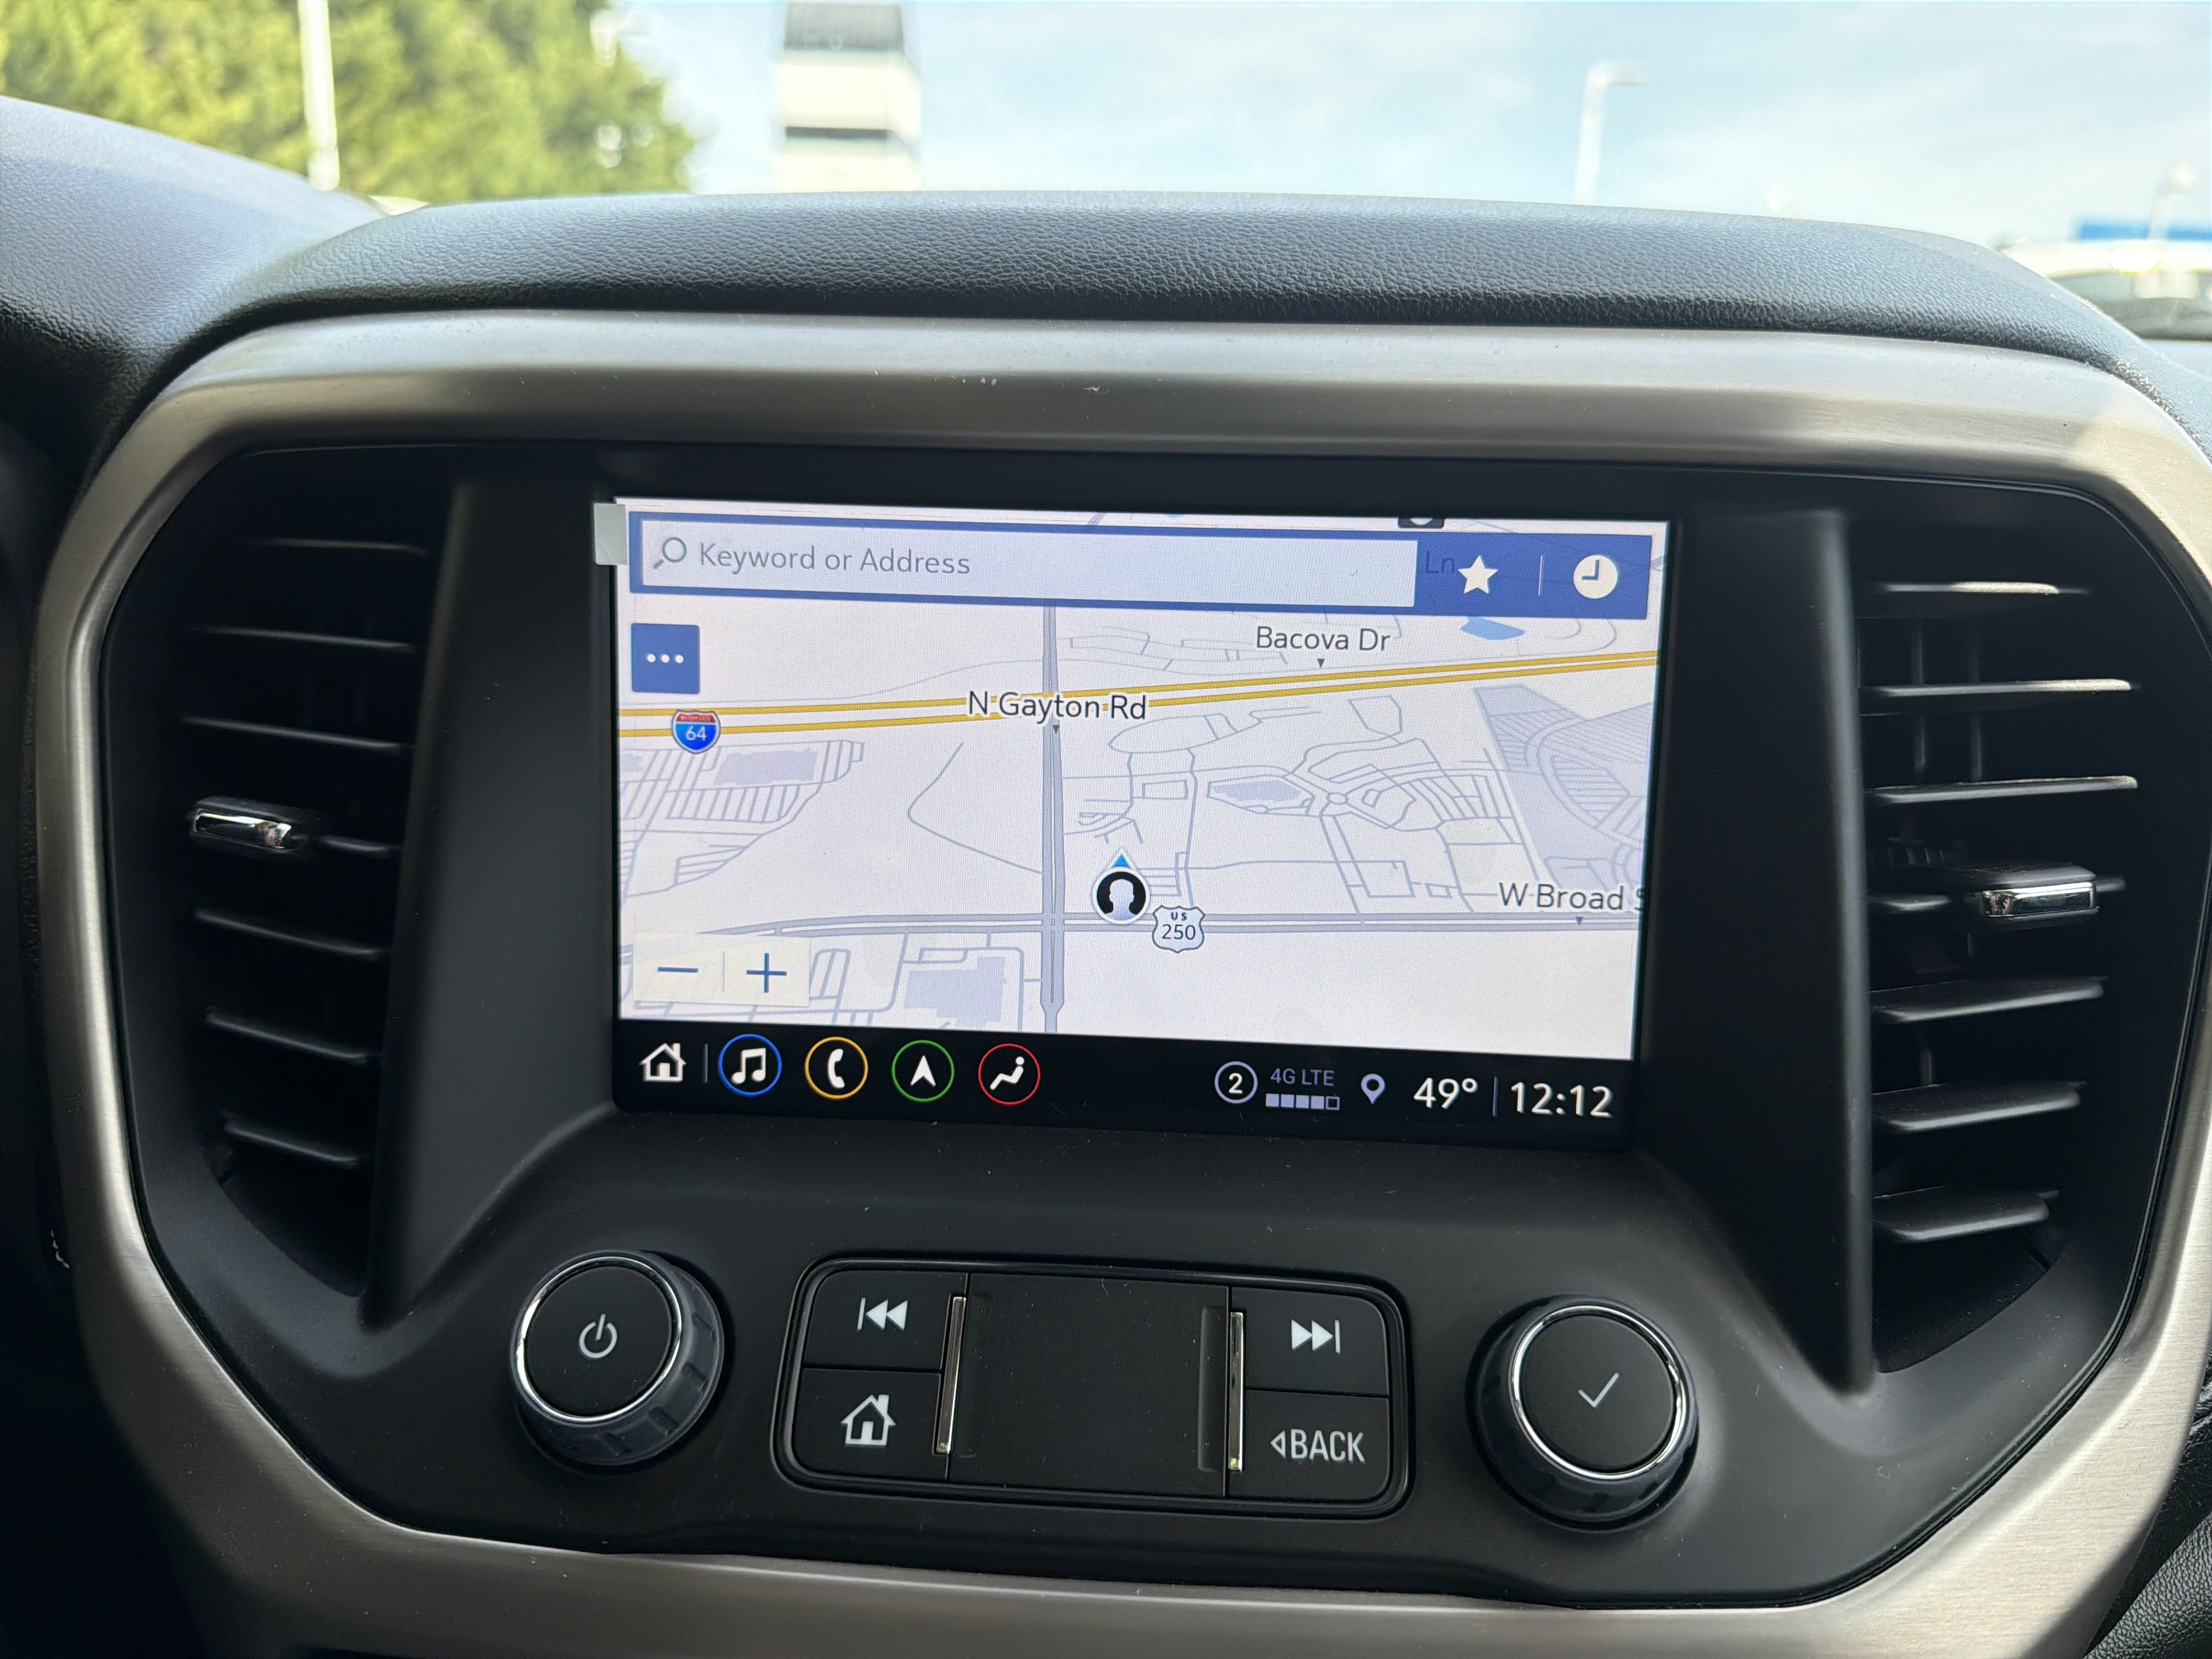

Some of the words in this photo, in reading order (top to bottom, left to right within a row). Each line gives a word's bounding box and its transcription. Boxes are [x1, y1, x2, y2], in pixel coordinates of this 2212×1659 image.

[700, 543, 816, 575] Keyword
[825, 553, 853, 571] or
[859, 548, 970, 574] Address
[1426, 551, 1455, 574] Ln
[1256, 626, 1348, 650] Bacova
[1359, 628, 1391, 651] Dr
[969, 691, 988, 715] N
[999, 692, 1099, 724] Gayton
[1111, 695, 1146, 720] Rd
[686, 725, 707, 742] 64
[1499, 882, 1528, 906] W
[1536, 883, 1624, 910] Broad
[1171, 911, 1187, 921] US
[1161, 924, 1196, 940] 250
[1228, 1073, 1243, 1094] 2
[1270, 1068, 1296, 1085] 4G
[1301, 1069, 1335, 1087] LTE
[1413, 1077, 1479, 1109] 49°
[1511, 1081, 1613, 1118] 12:12
[1290, 1429, 1366, 1464] BACK
